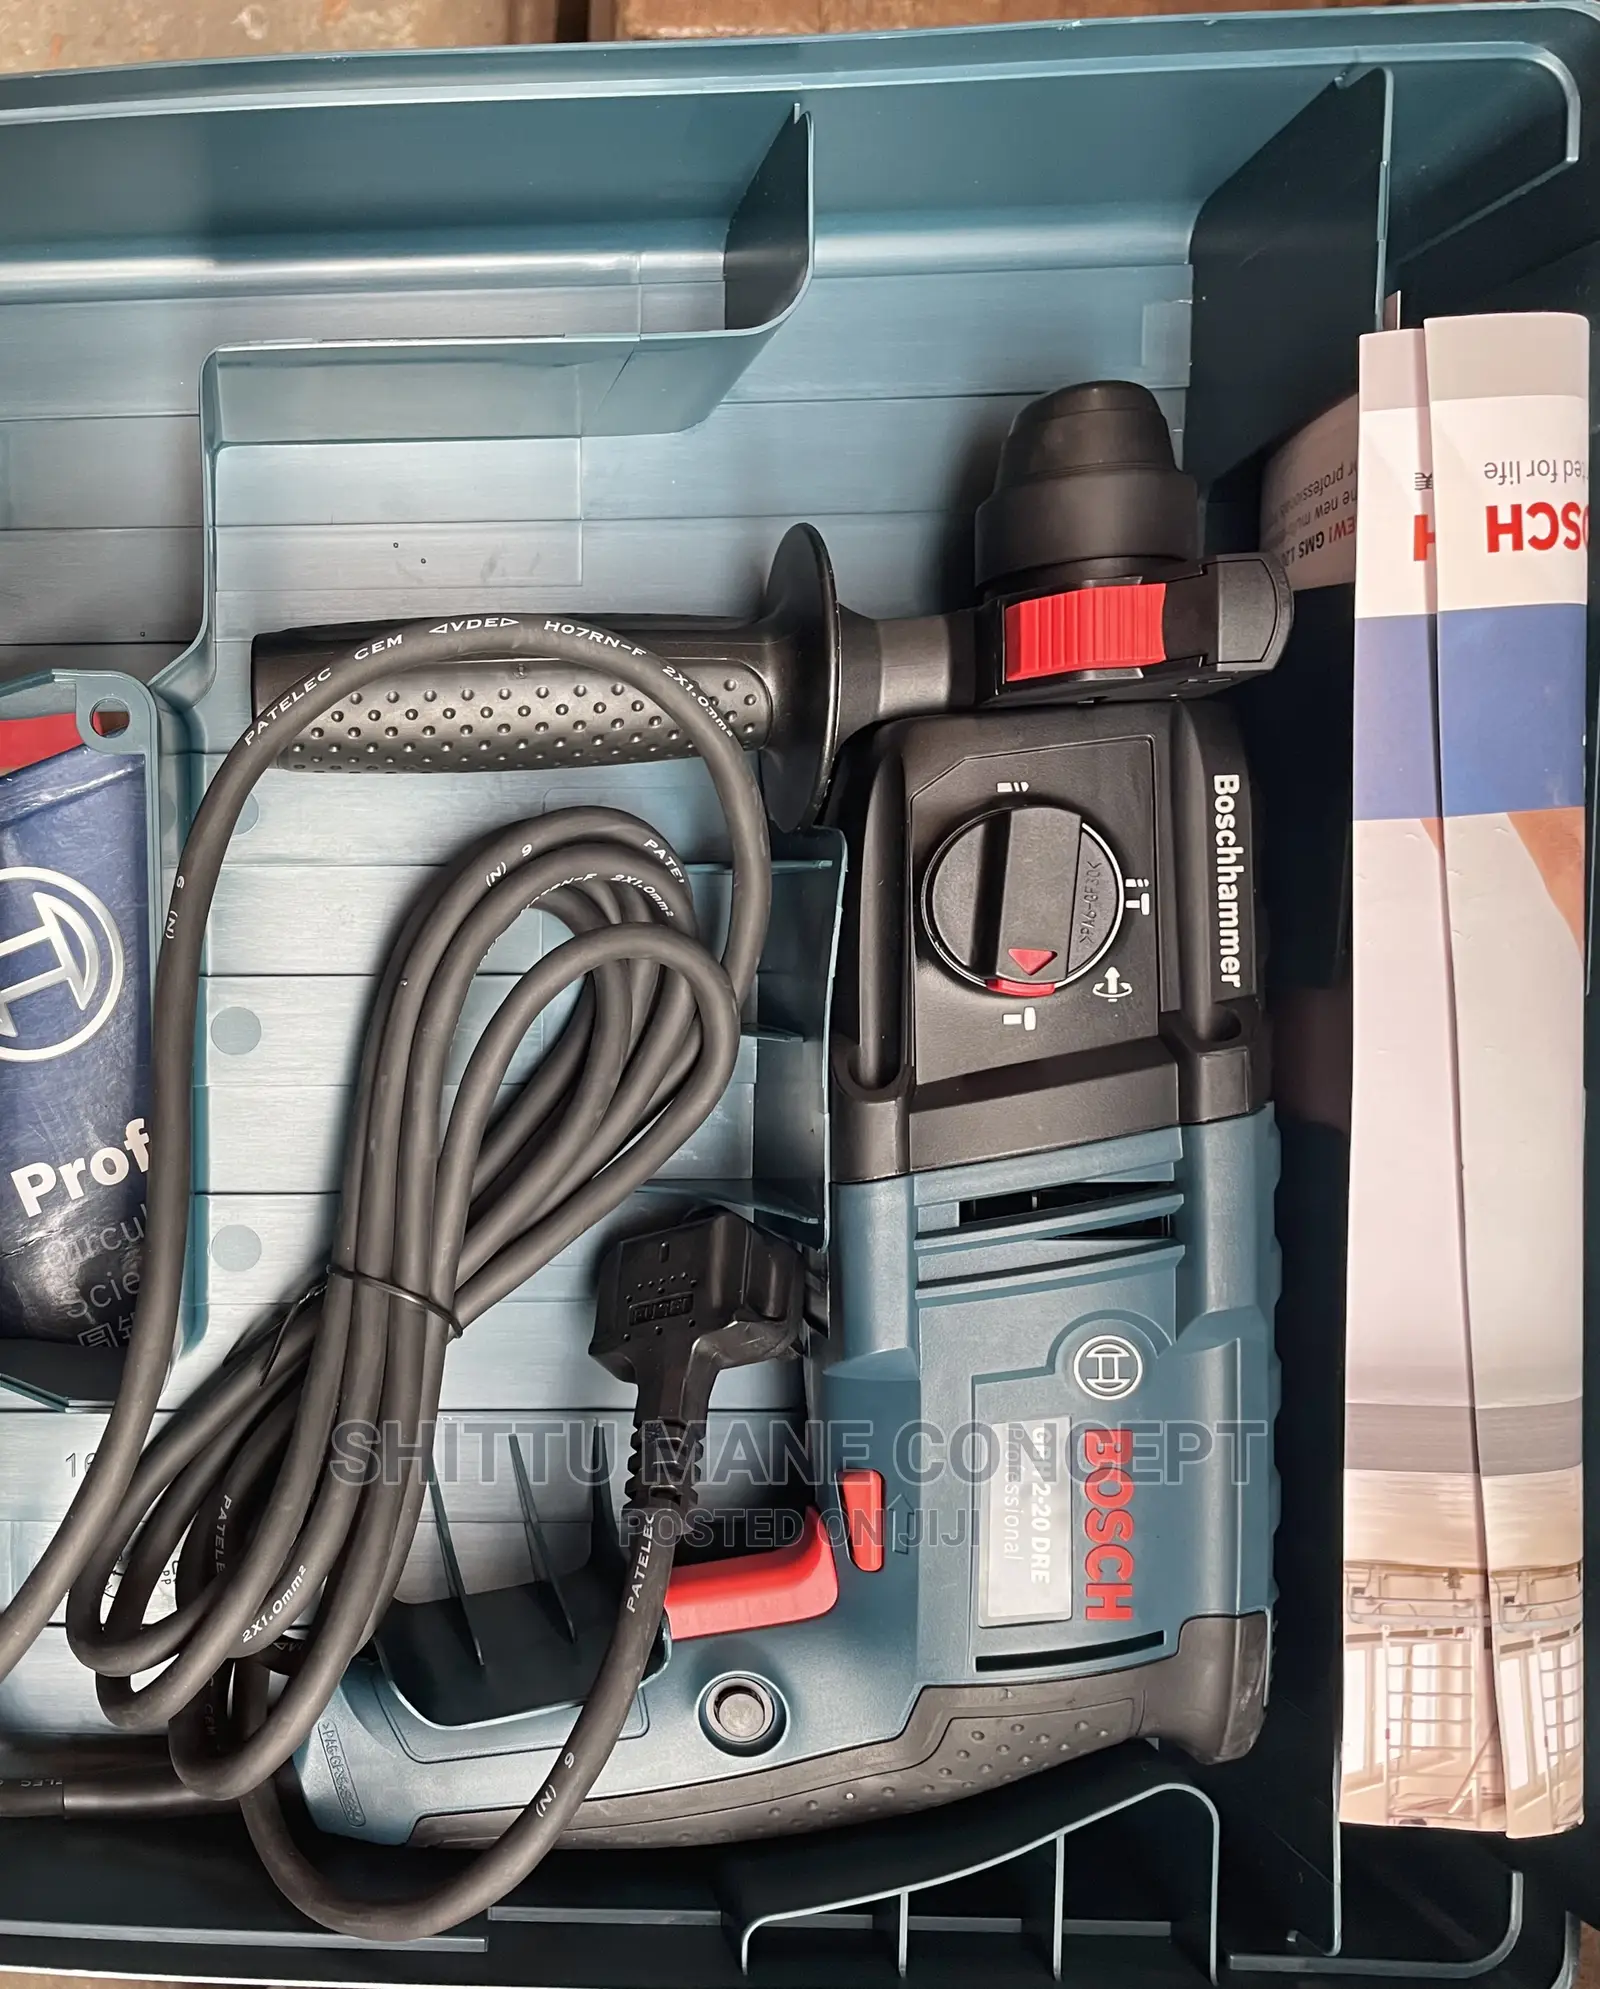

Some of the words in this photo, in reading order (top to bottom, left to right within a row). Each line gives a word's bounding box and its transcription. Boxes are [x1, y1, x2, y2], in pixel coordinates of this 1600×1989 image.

[1484, 460, 1521, 486] life
[1526, 459, 1557, 483] for
[1314, 496, 1339, 520] new
[1298, 531, 1324, 559] GMS
[244, 667, 332, 747] PATELEC
[353, 634, 403, 661] CEM
[450, 617, 500, 632] VDE
[485, 861, 507, 888] (N)
[521, 844, 533, 857] 9
[1213, 774, 1245, 988] Boschhammer
[10, 1117, 150, 1218] Prof
[1003, 1425, 1025, 1561] Professional
[1031, 1482, 1051, 1532] 2-20
[1084, 1428, 1135, 1621] BOSCH
[1031, 1537, 1051, 1585] DRE
[535, 1783, 557, 1818] (N)
[564, 1751, 575, 1768] 9
[626, 1513, 656, 1613] PATELEC
